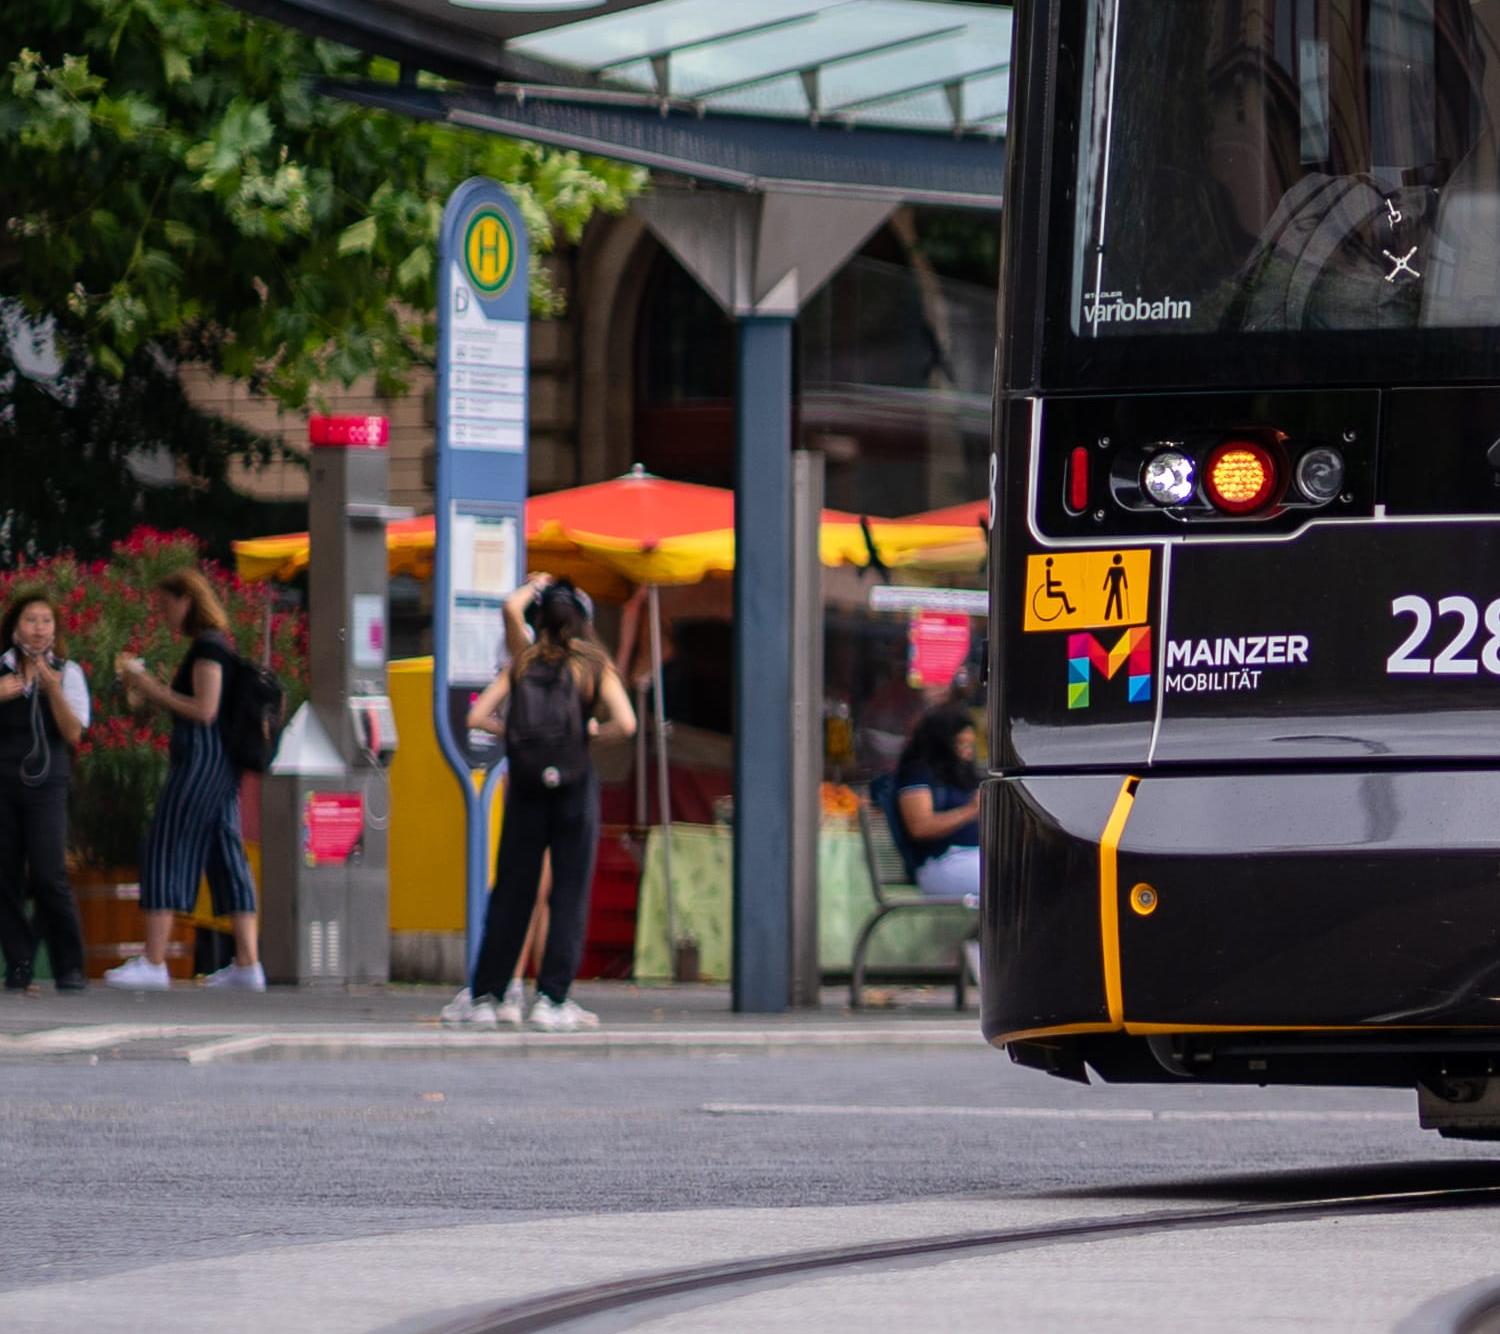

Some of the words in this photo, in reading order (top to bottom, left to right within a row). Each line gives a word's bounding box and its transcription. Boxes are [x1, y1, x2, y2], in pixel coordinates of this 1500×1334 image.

[479, 223, 500, 274] H
[1083, 296, 1191, 323] variobahn
[1167, 635, 1309, 667] MAINZER
[1165, 670, 1262, 693] MOBILITÄT
